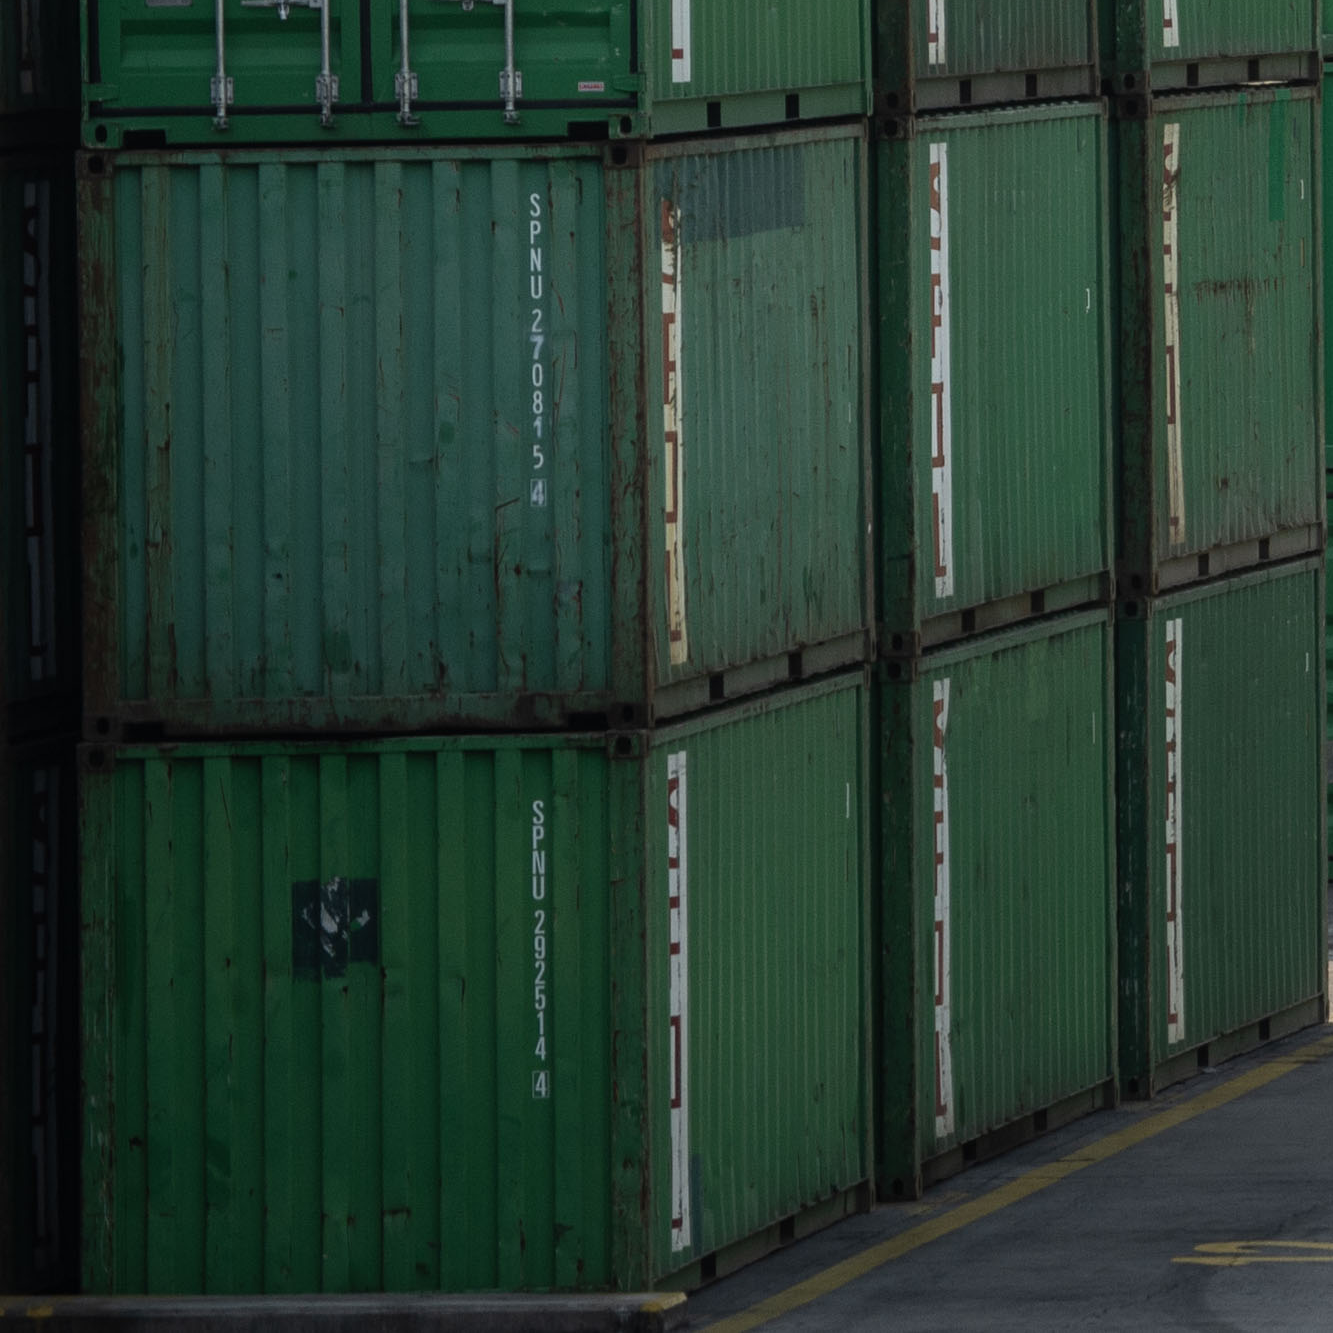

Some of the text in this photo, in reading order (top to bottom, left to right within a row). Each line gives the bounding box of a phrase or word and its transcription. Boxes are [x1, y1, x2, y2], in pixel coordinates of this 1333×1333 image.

[530, 194, 545, 506] SPNU 270815 4
[532, 800, 547, 1097] SPNU 292514 4
